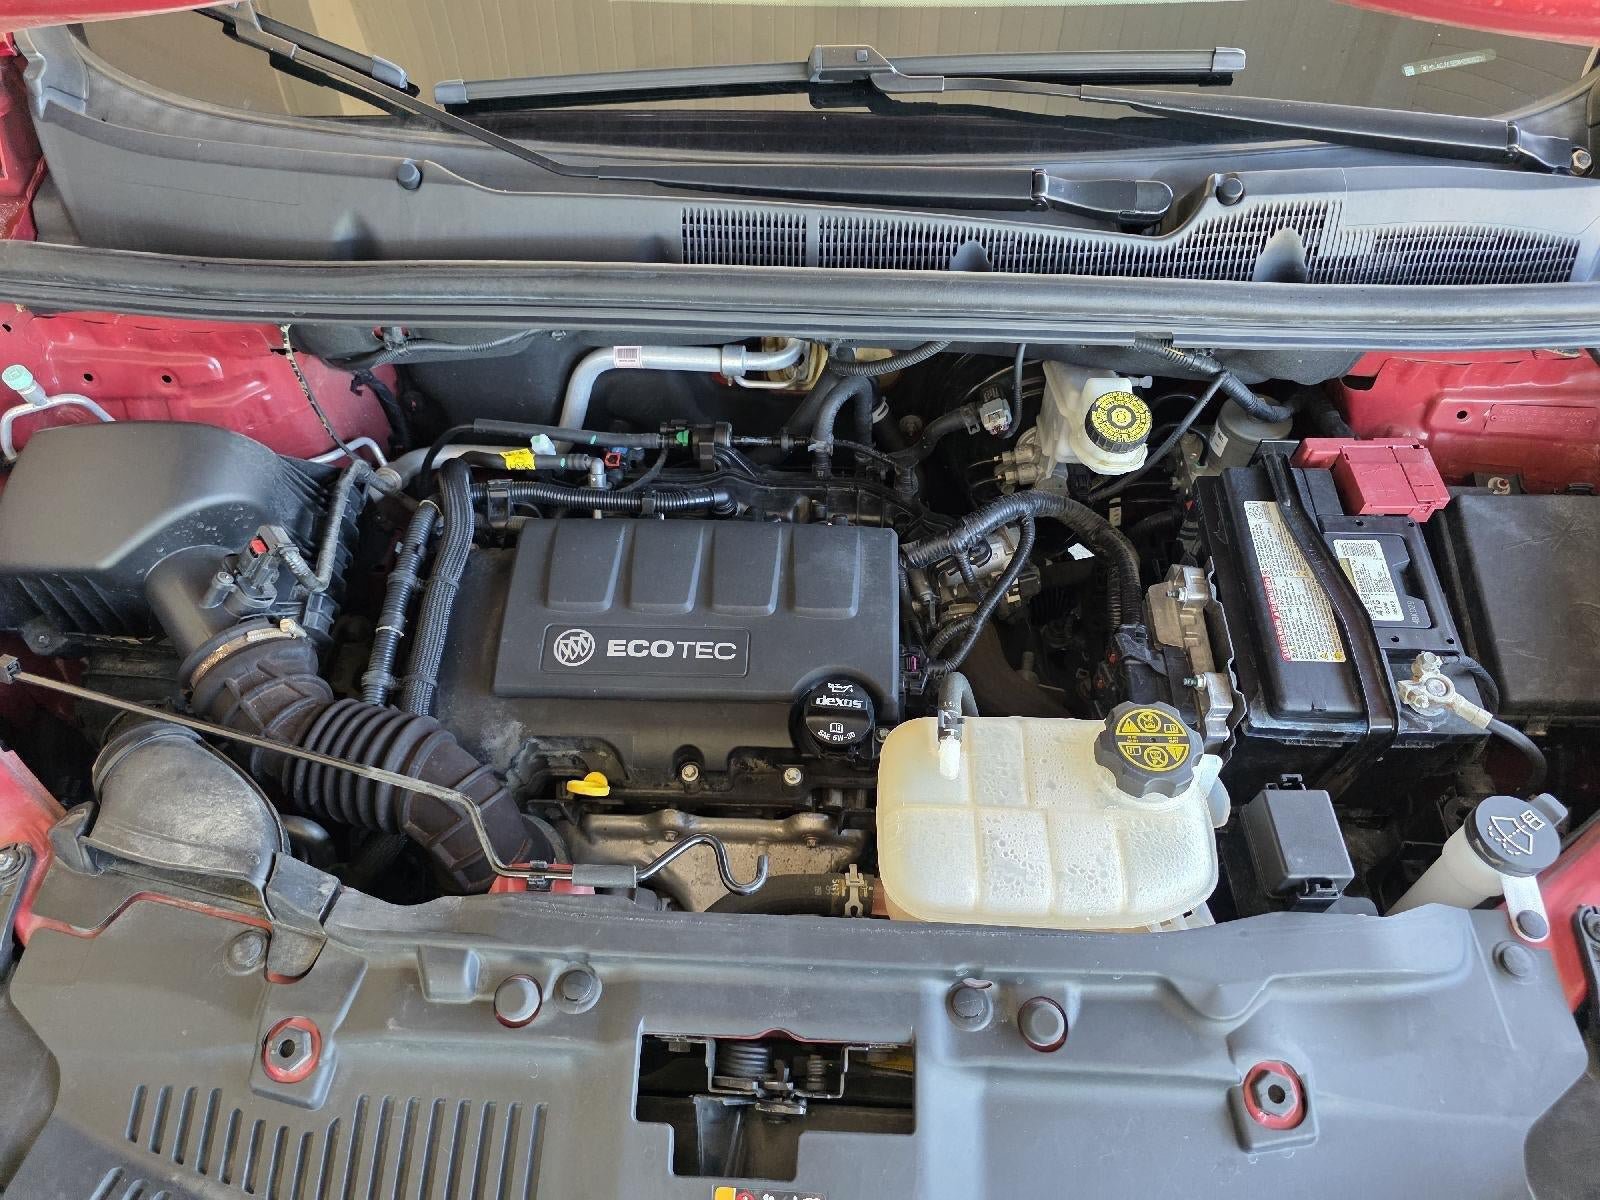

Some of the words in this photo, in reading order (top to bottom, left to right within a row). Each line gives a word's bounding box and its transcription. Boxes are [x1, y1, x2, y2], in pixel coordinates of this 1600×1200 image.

[606, 639, 737, 660] ECOTEC
[815, 694, 864, 709] dexos
[817, 730, 831, 741] SAE
